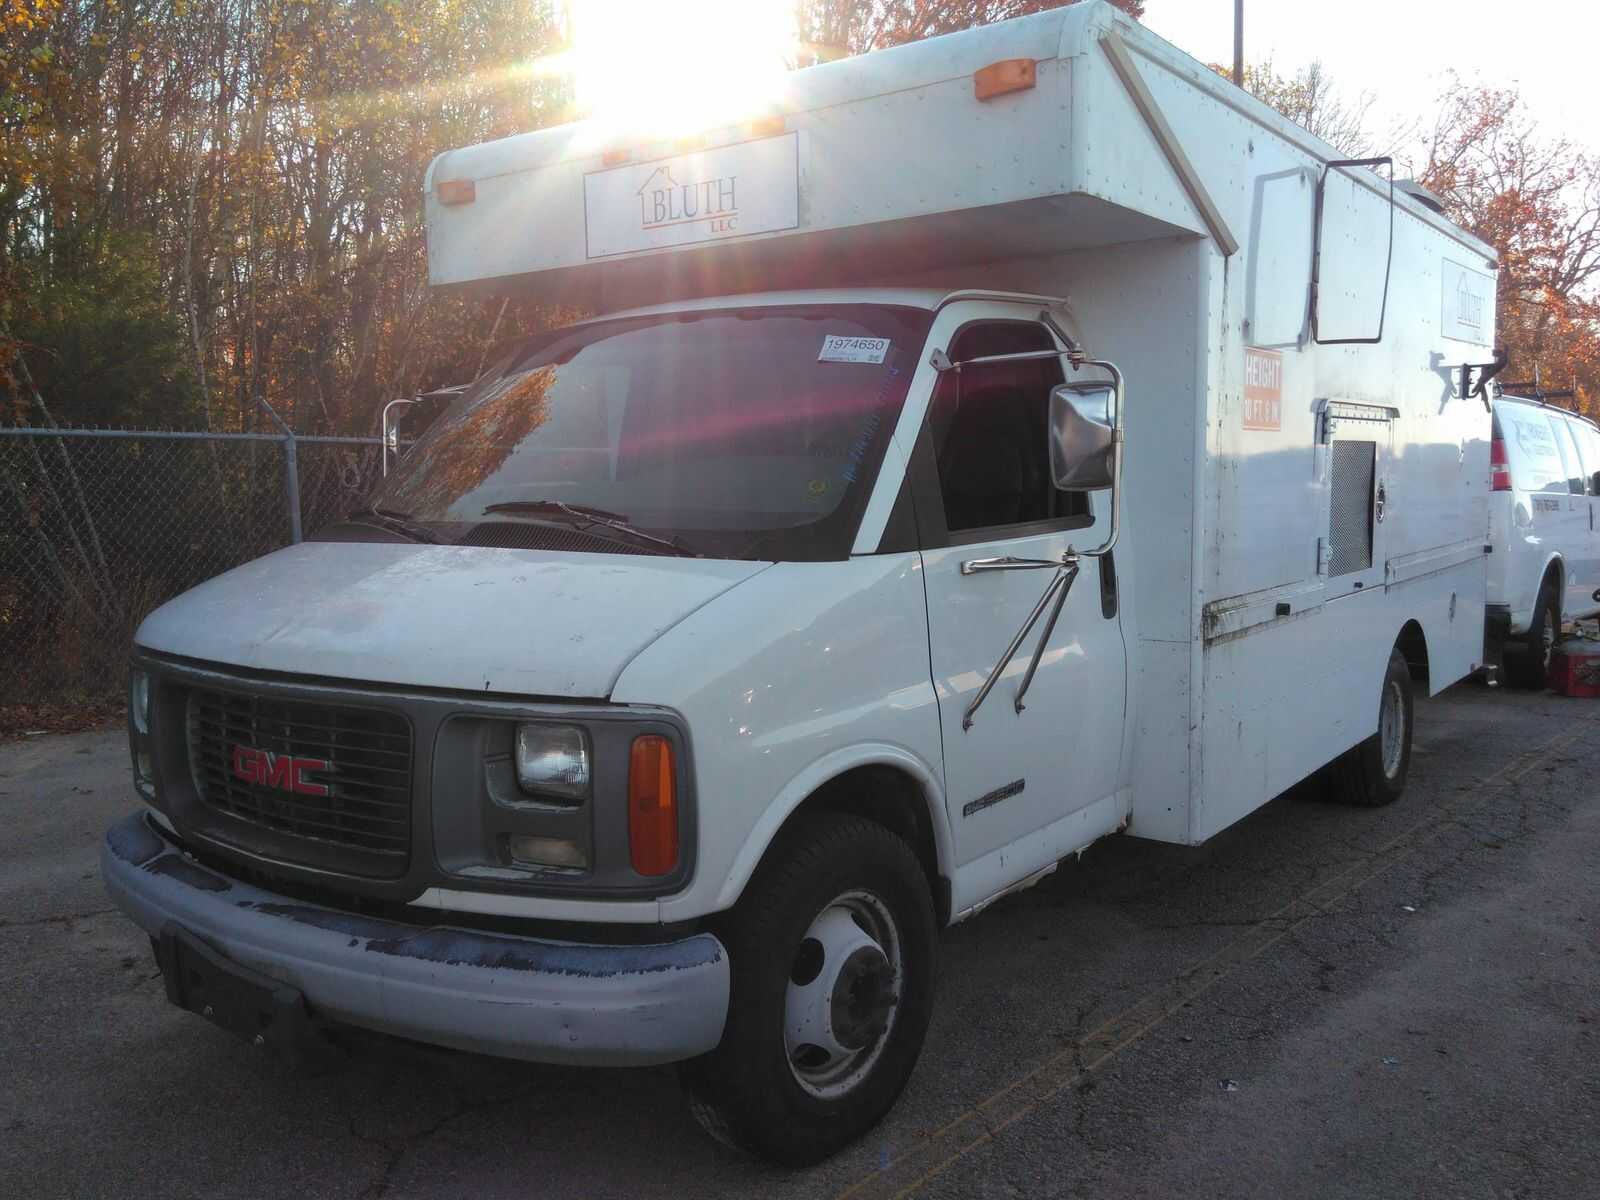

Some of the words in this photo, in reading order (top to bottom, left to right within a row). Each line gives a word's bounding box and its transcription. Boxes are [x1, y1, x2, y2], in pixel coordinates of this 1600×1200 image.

[652, 176, 739, 223] BLUTH
[710, 217, 738, 233] LLC
[828, 339, 884, 351] 1974650
[1247, 354, 1280, 389] HEIGHT
[231, 744, 329, 796] GMC
